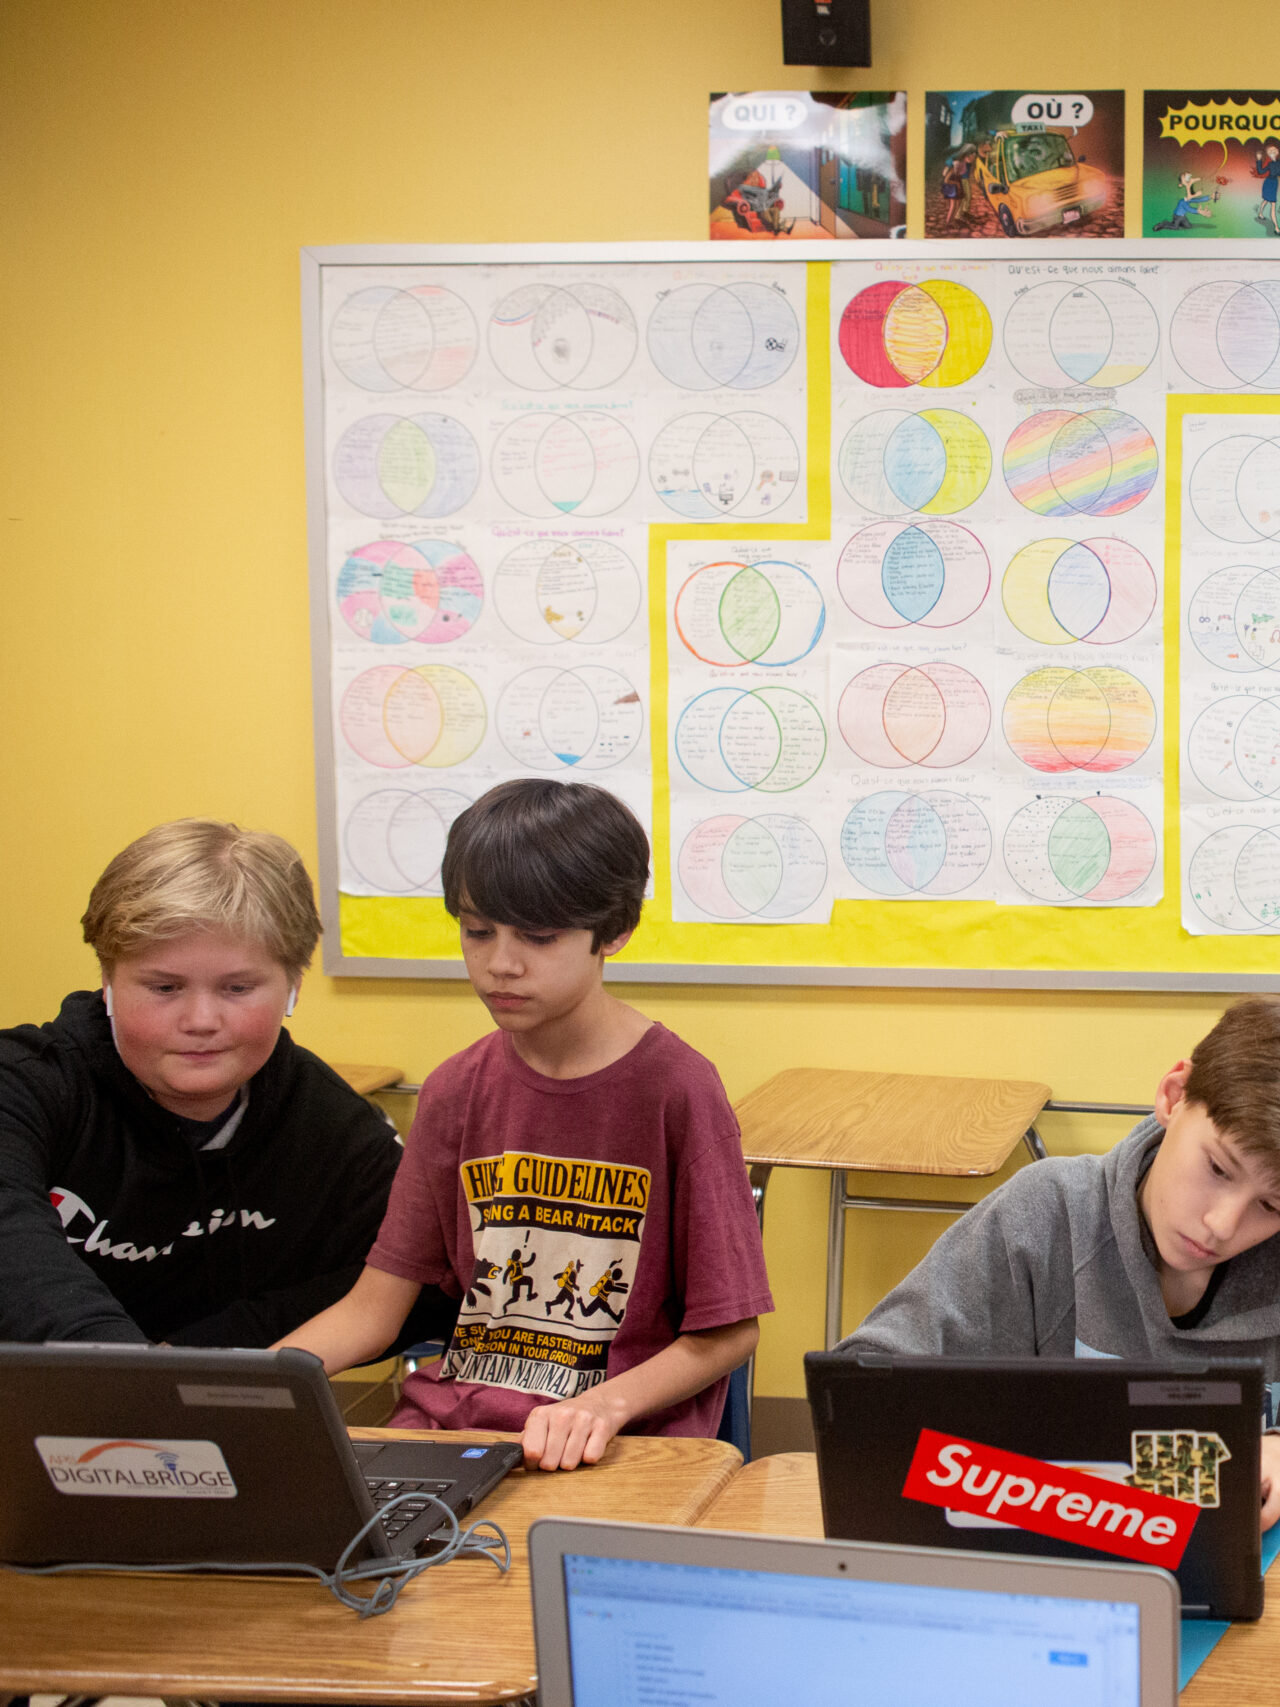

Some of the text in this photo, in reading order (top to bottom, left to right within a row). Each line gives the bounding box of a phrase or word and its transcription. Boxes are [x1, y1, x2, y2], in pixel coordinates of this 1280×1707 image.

[734, 102, 797, 123] QUI ?
[1027, 98, 1084, 119] OÙ ?
[1021, 124, 1043, 132] TAXI
[513, 1157, 649, 1209] GUIDELINES
[517, 1204, 531, 1221] A
[535, 1206, 574, 1226] BEAR
[575, 1211, 638, 1235] ATTACK
[508, 1342, 521, 1355] IN
[521, 1344, 549, 1360] YOUR
[549, 1349, 578, 1367] GROUP
[512, 1330, 536, 1345] ARE
[536, 1333, 573, 1351] FASTER
[572, 1340, 604, 1356] THAN
[511, 1359, 572, 1398] NATIONAL
[50, 1466, 233, 1487] DIGITALBRIDGE
[925, 1443, 1178, 1546] Supreme
